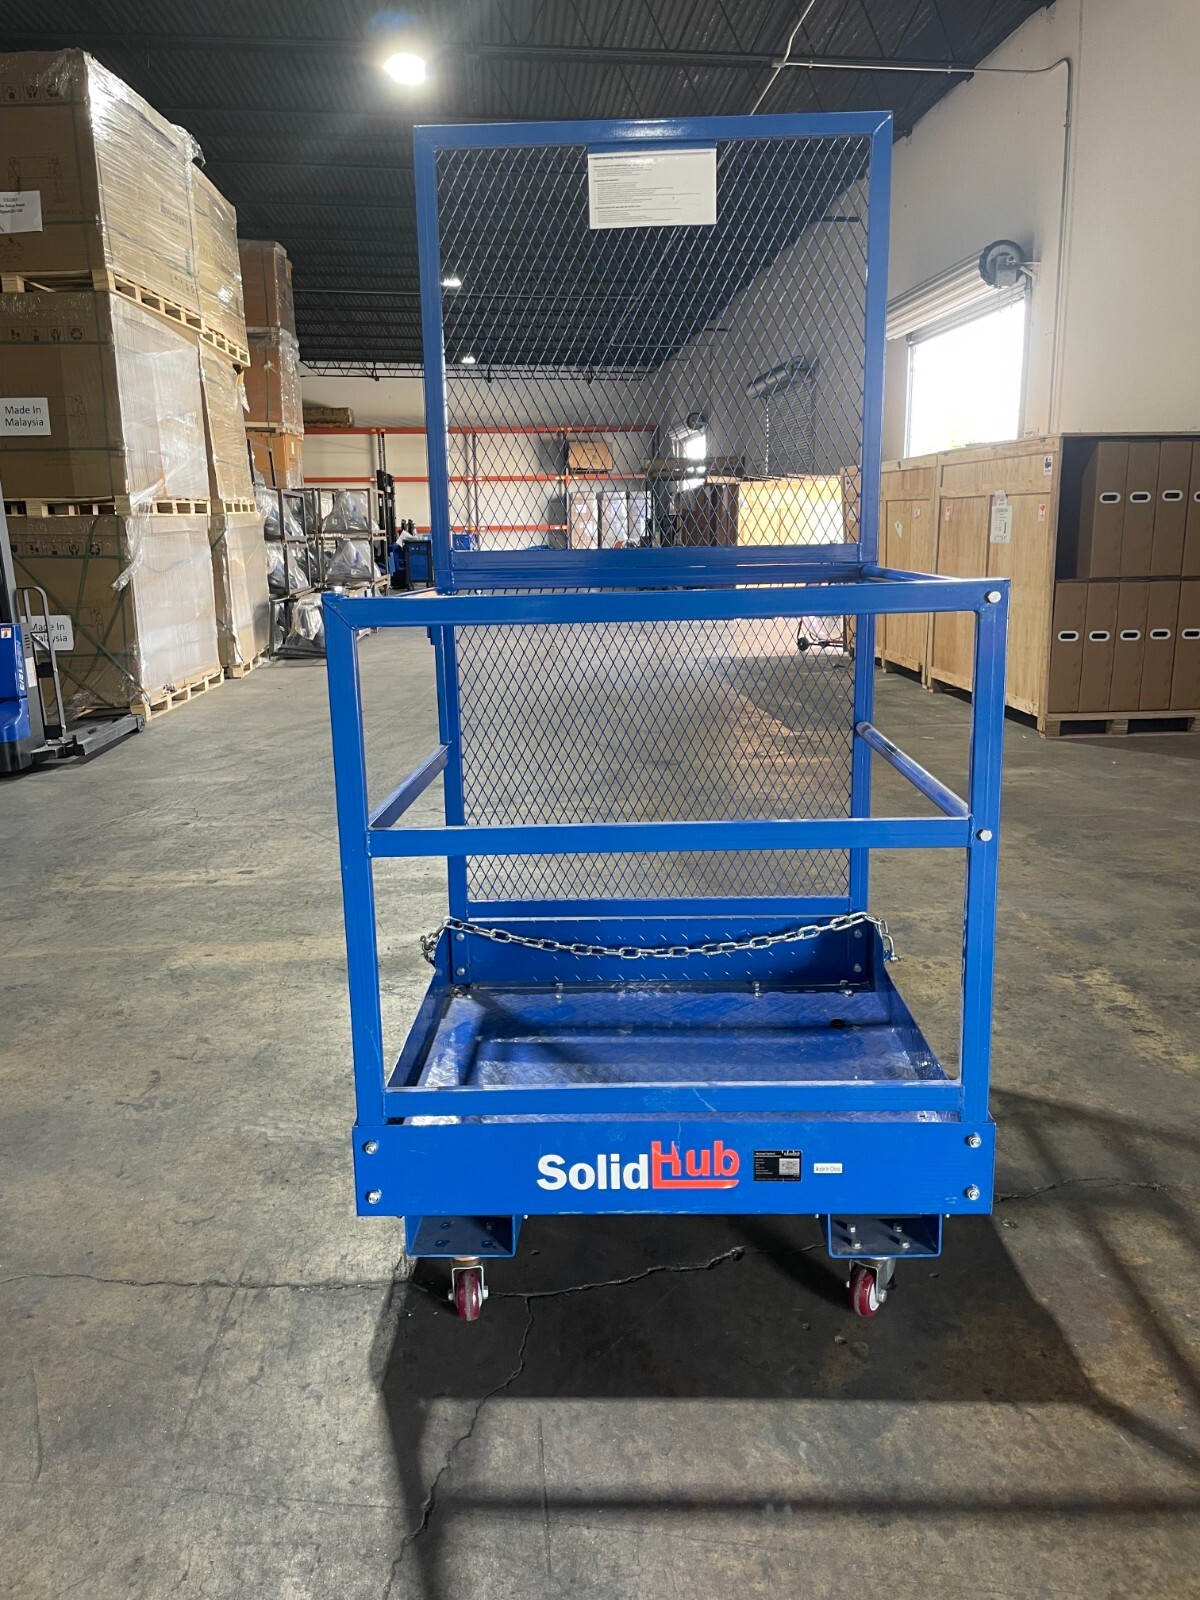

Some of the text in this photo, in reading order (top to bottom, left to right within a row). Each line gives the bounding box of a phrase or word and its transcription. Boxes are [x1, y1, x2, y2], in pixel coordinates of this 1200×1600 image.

[5, 405, 41, 414] Made In
[5, 417, 44, 427] Malaysia
[56, 622, 65, 631] In
[536, 1140, 740, 1190] SolidHub
